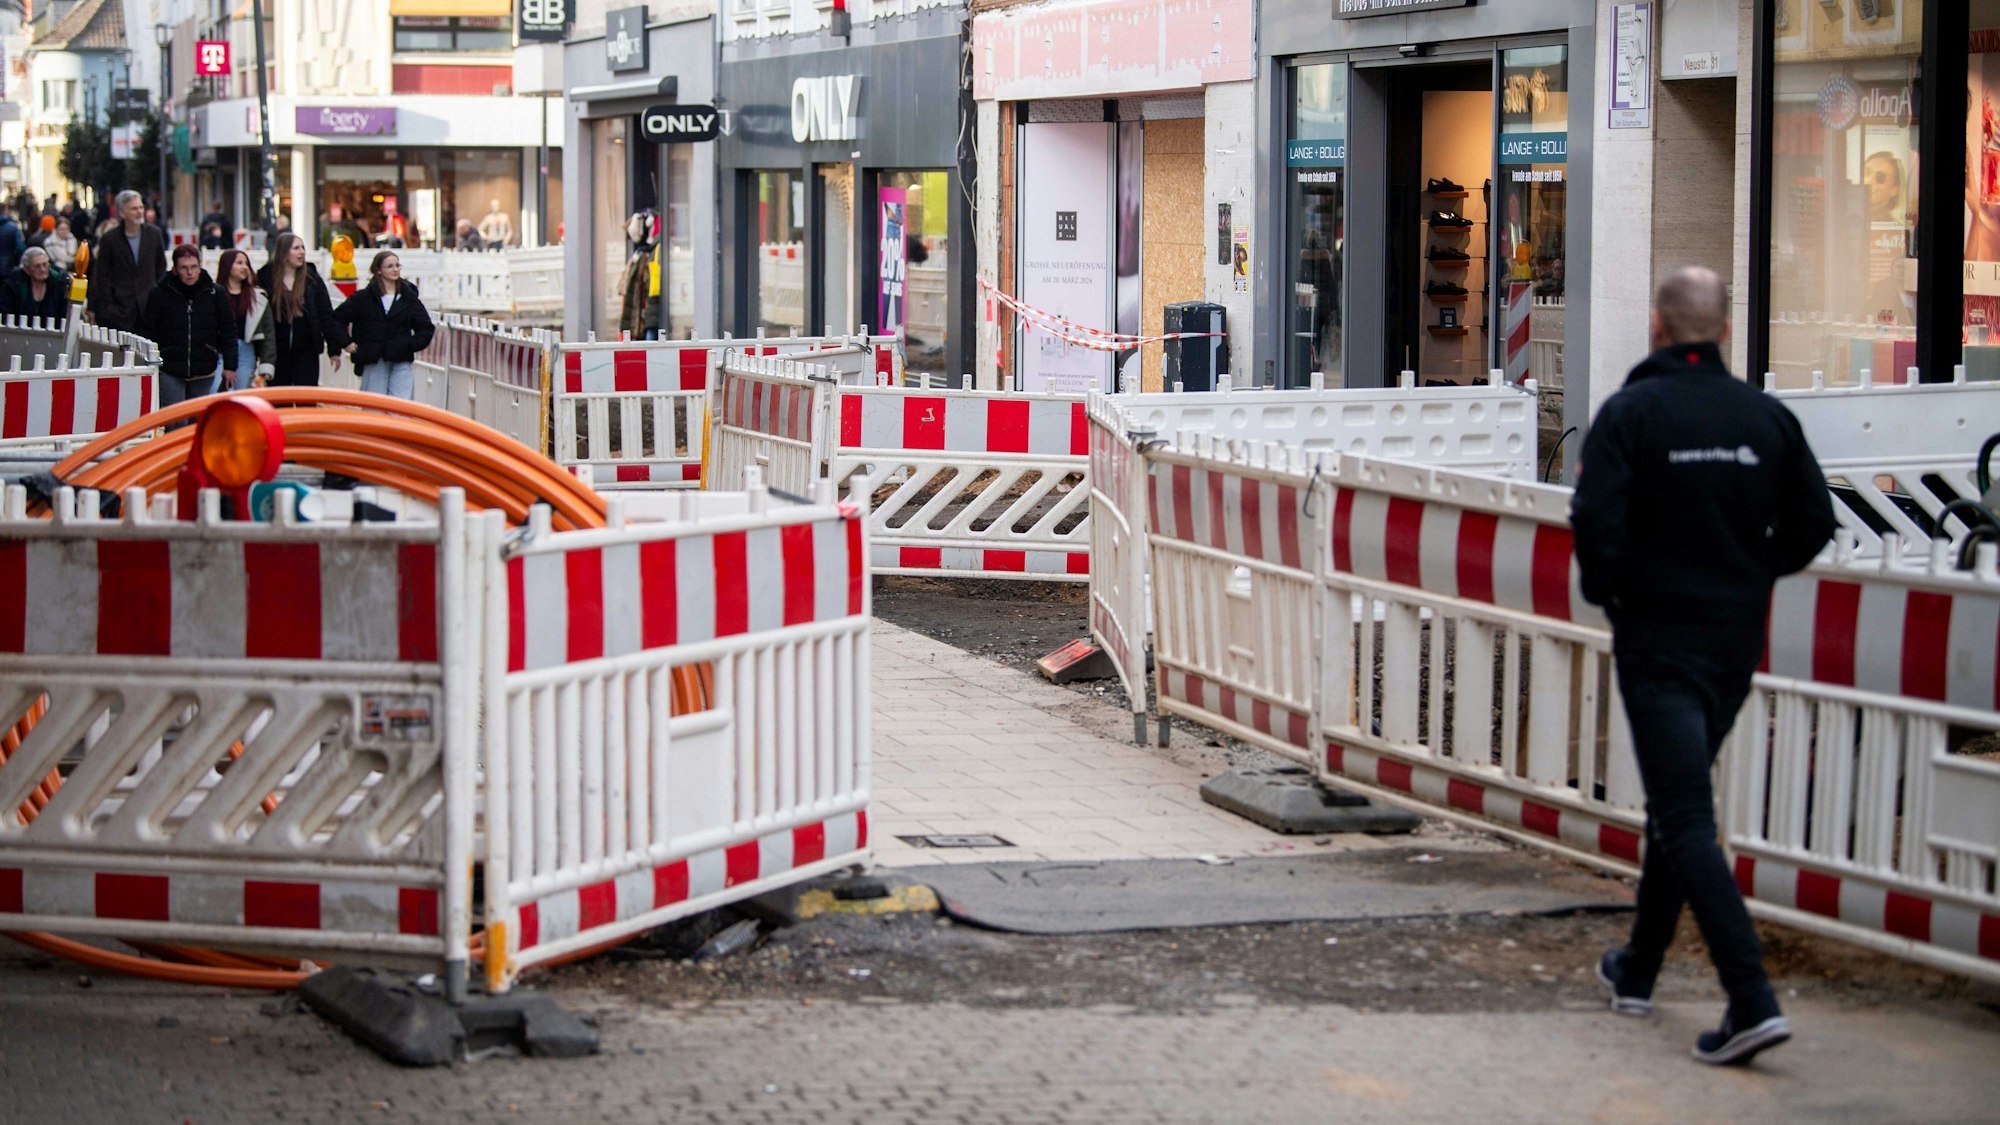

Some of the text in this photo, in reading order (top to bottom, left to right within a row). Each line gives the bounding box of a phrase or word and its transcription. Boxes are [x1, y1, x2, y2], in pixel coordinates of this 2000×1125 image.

[202, 44, 225, 72] T
[1684, 56, 1718, 71] Neustr. 31
[320, 107, 369, 129] liberty
[790, 75, 861, 143] ONLY
[647, 114, 715, 133] ONLY
[1290, 147, 1313, 159] LANGE
[1320, 146, 1344, 158] BOLLIG
[1502, 141, 1532, 155] LANGE
[1541, 140, 1566, 155] BOLLI
[880, 238, 906, 282] 20%
[1024, 260, 1106, 270] GROSSE NEUERÖFFNUNG
